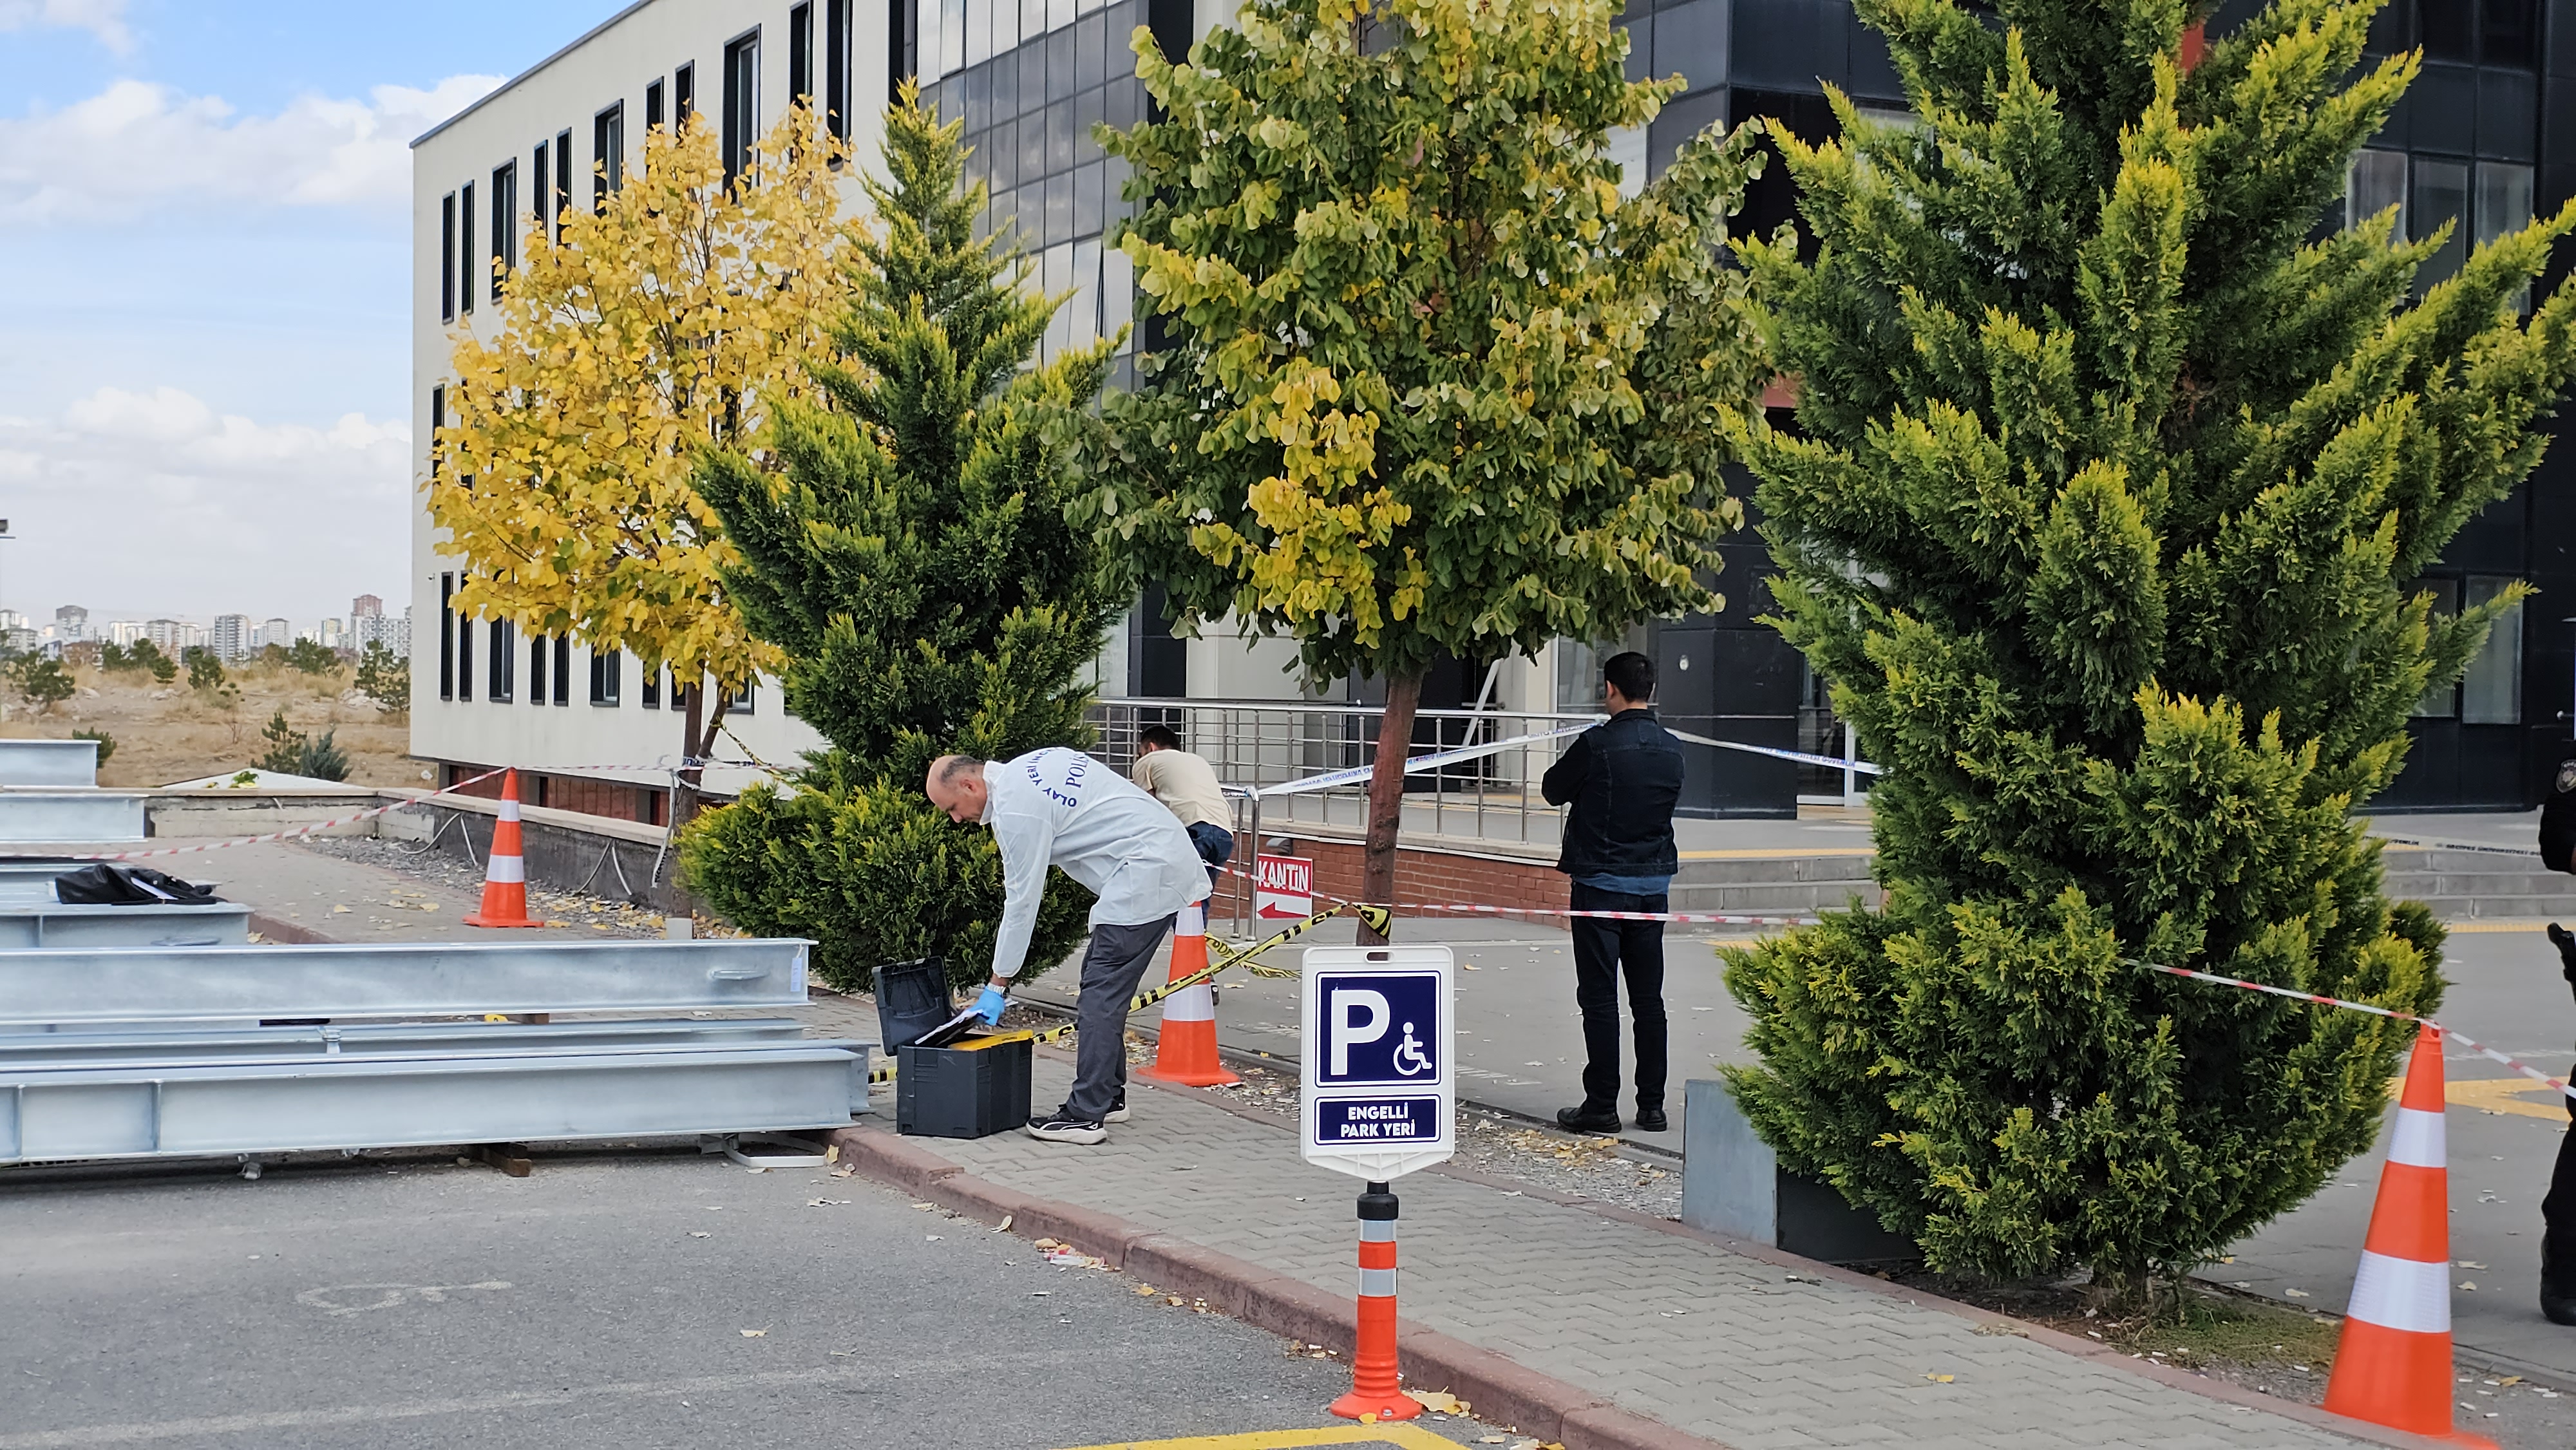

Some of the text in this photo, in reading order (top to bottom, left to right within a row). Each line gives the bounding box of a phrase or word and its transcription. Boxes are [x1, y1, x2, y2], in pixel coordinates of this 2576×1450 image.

[1042, 787, 1077, 807] OLAY
[1330, 989, 1390, 1076] P
[1348, 1102, 1408, 1120] ENGELLİ
[1341, 1118, 1416, 1137] PARK YERİ
